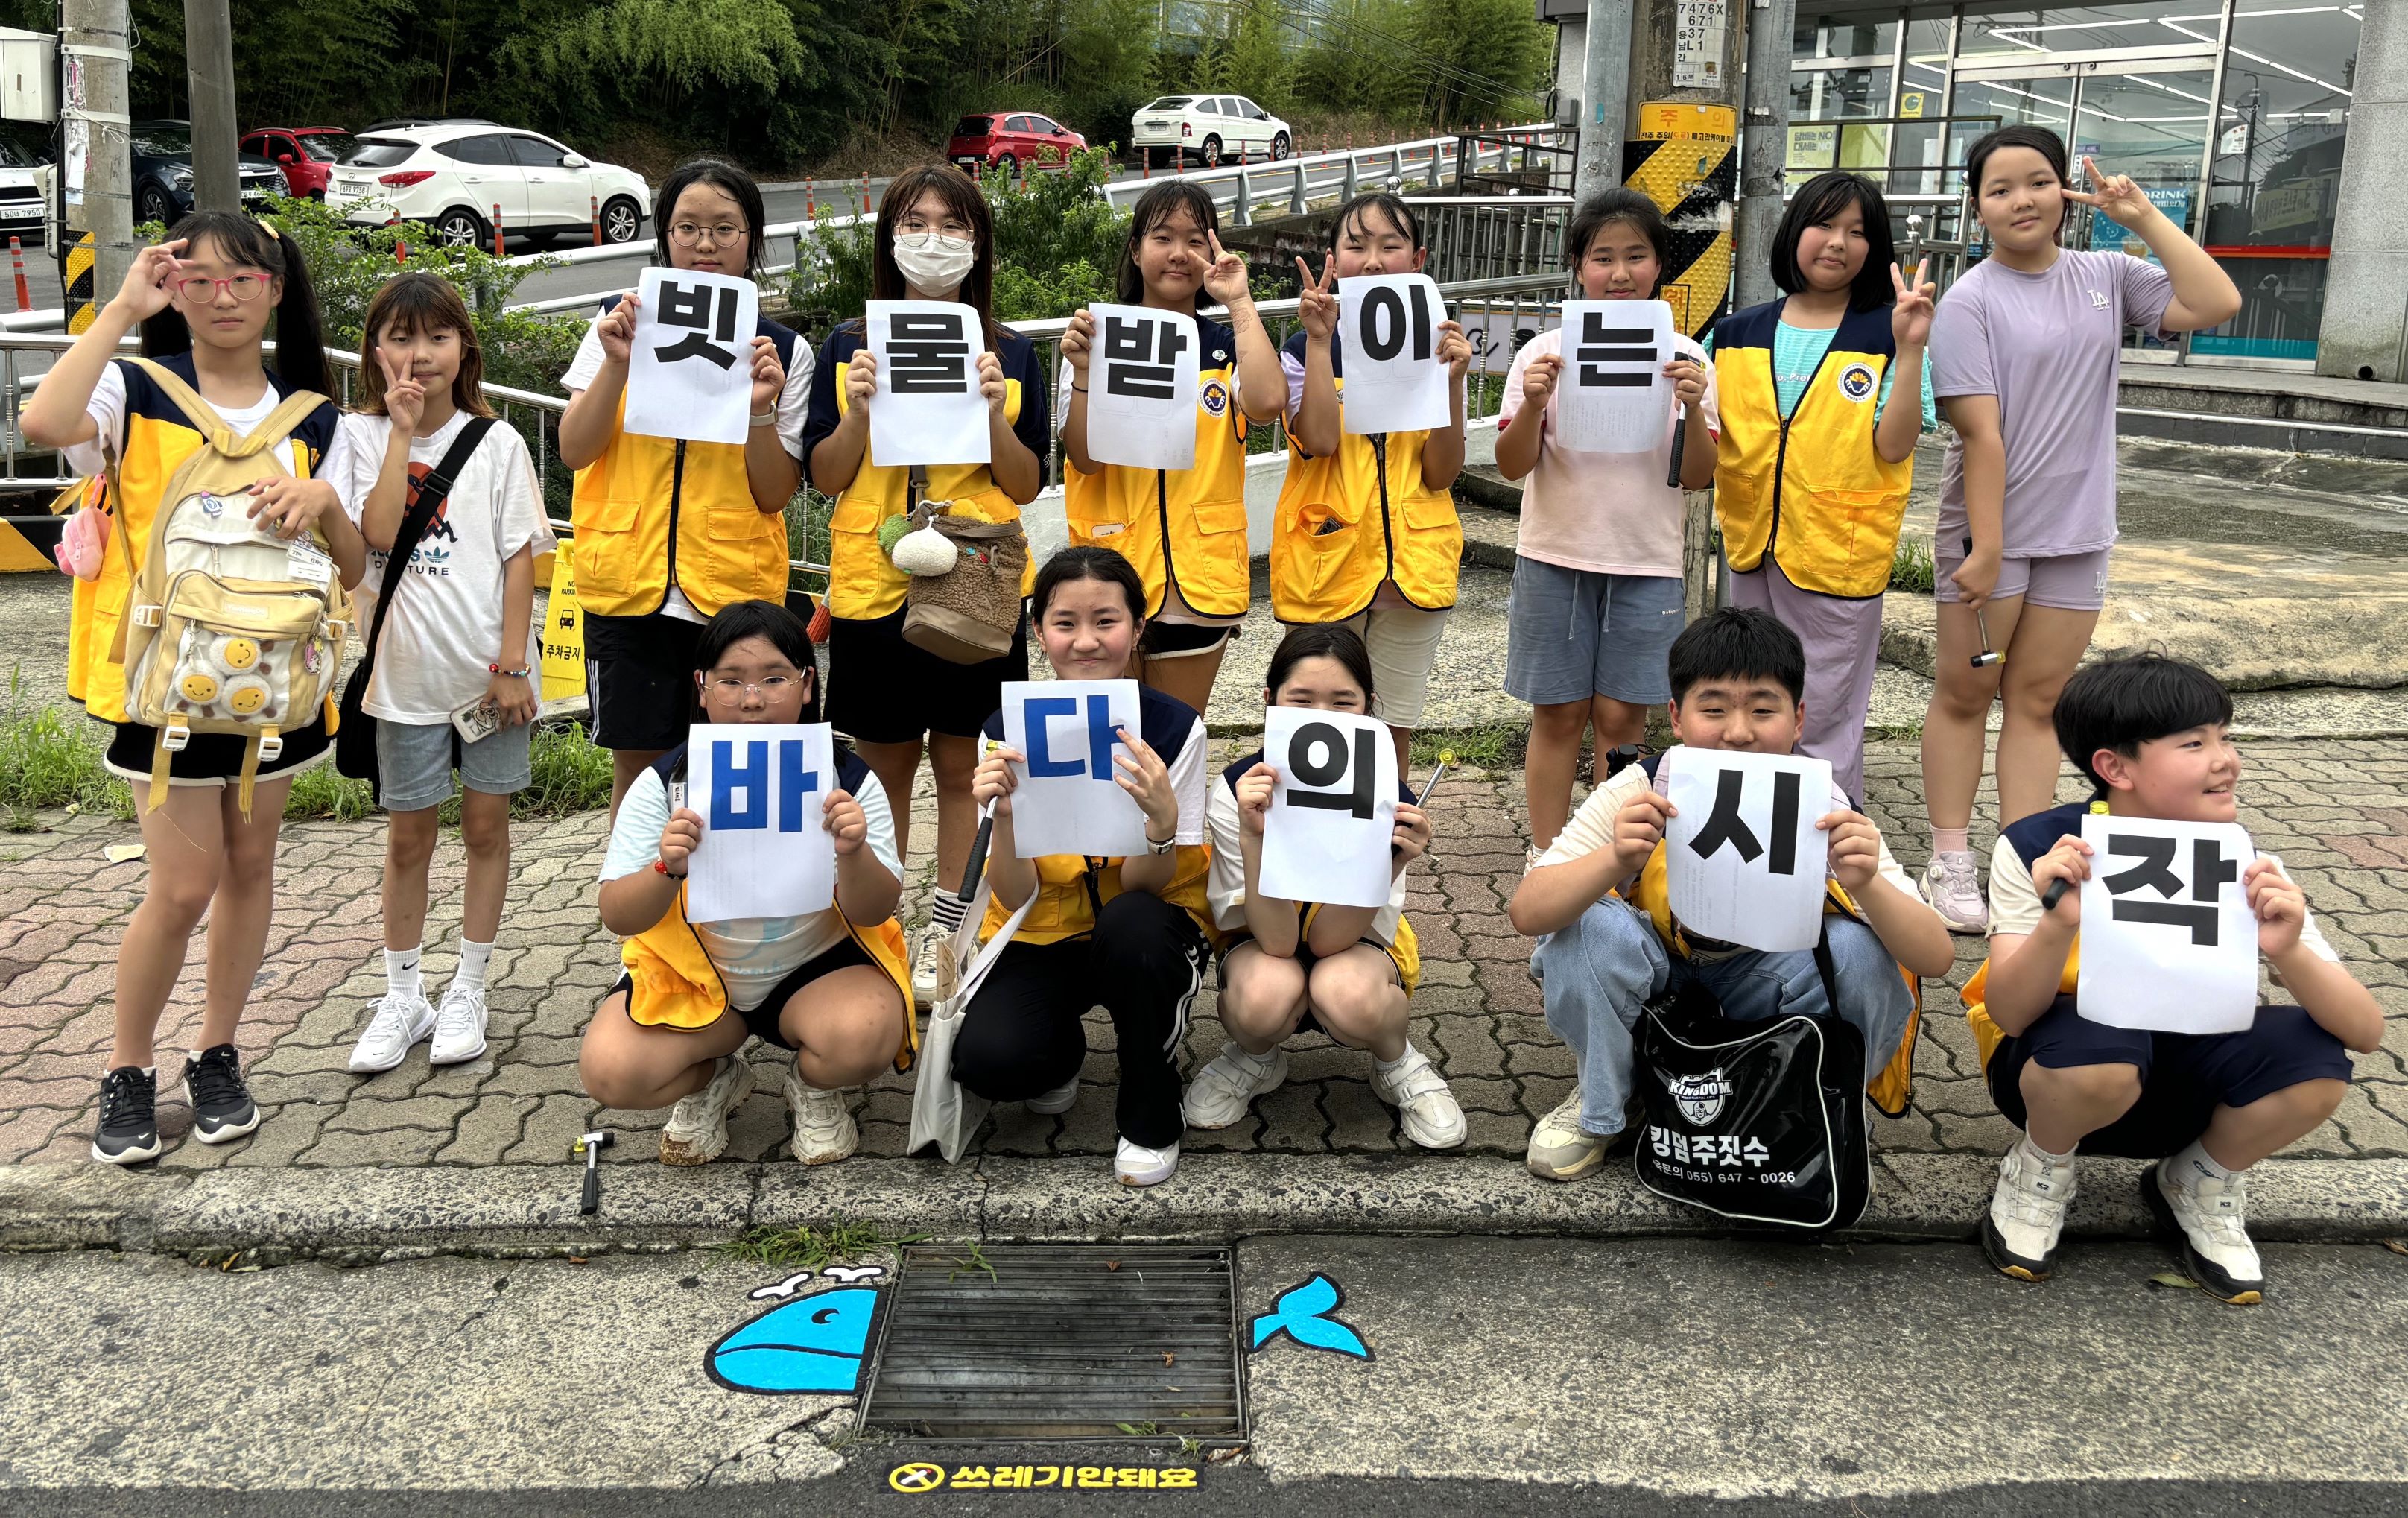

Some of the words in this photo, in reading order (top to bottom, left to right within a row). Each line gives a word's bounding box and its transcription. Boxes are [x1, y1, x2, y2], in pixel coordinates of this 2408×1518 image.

[1678, 4, 1723, 15] 7476X
[1688, 16, 1713, 26] 671
[1688, 28, 1705, 39] 37
[1660, 110, 1678, 127] 주
[654, 281, 738, 370] 빗
[1360, 285, 1430, 361] 이
[2087, 289, 2110, 311] LA
[886, 314, 969, 393] 물
[1105, 317, 1186, 399] 받
[1577, 312, 1657, 387] 는
[546, 644, 580, 661] 주차금지
[1024, 695, 1124, 780] 다
[710, 740, 818, 832] 바
[1287, 722, 1375, 819] 의
[1688, 769, 1801, 875] 시
[2102, 834, 2237, 946] 작
[1670, 1080, 1731, 1096] KINGDOM
[1650, 1125, 1769, 1166] 킹덤주짓수
[1687, 1170, 1713, 1183] 055)
[1718, 1173, 1742, 1183] 647
[1760, 1171, 1796, 1184] 0026
[950, 1465, 1197, 1488] 쓰레기안돼요
